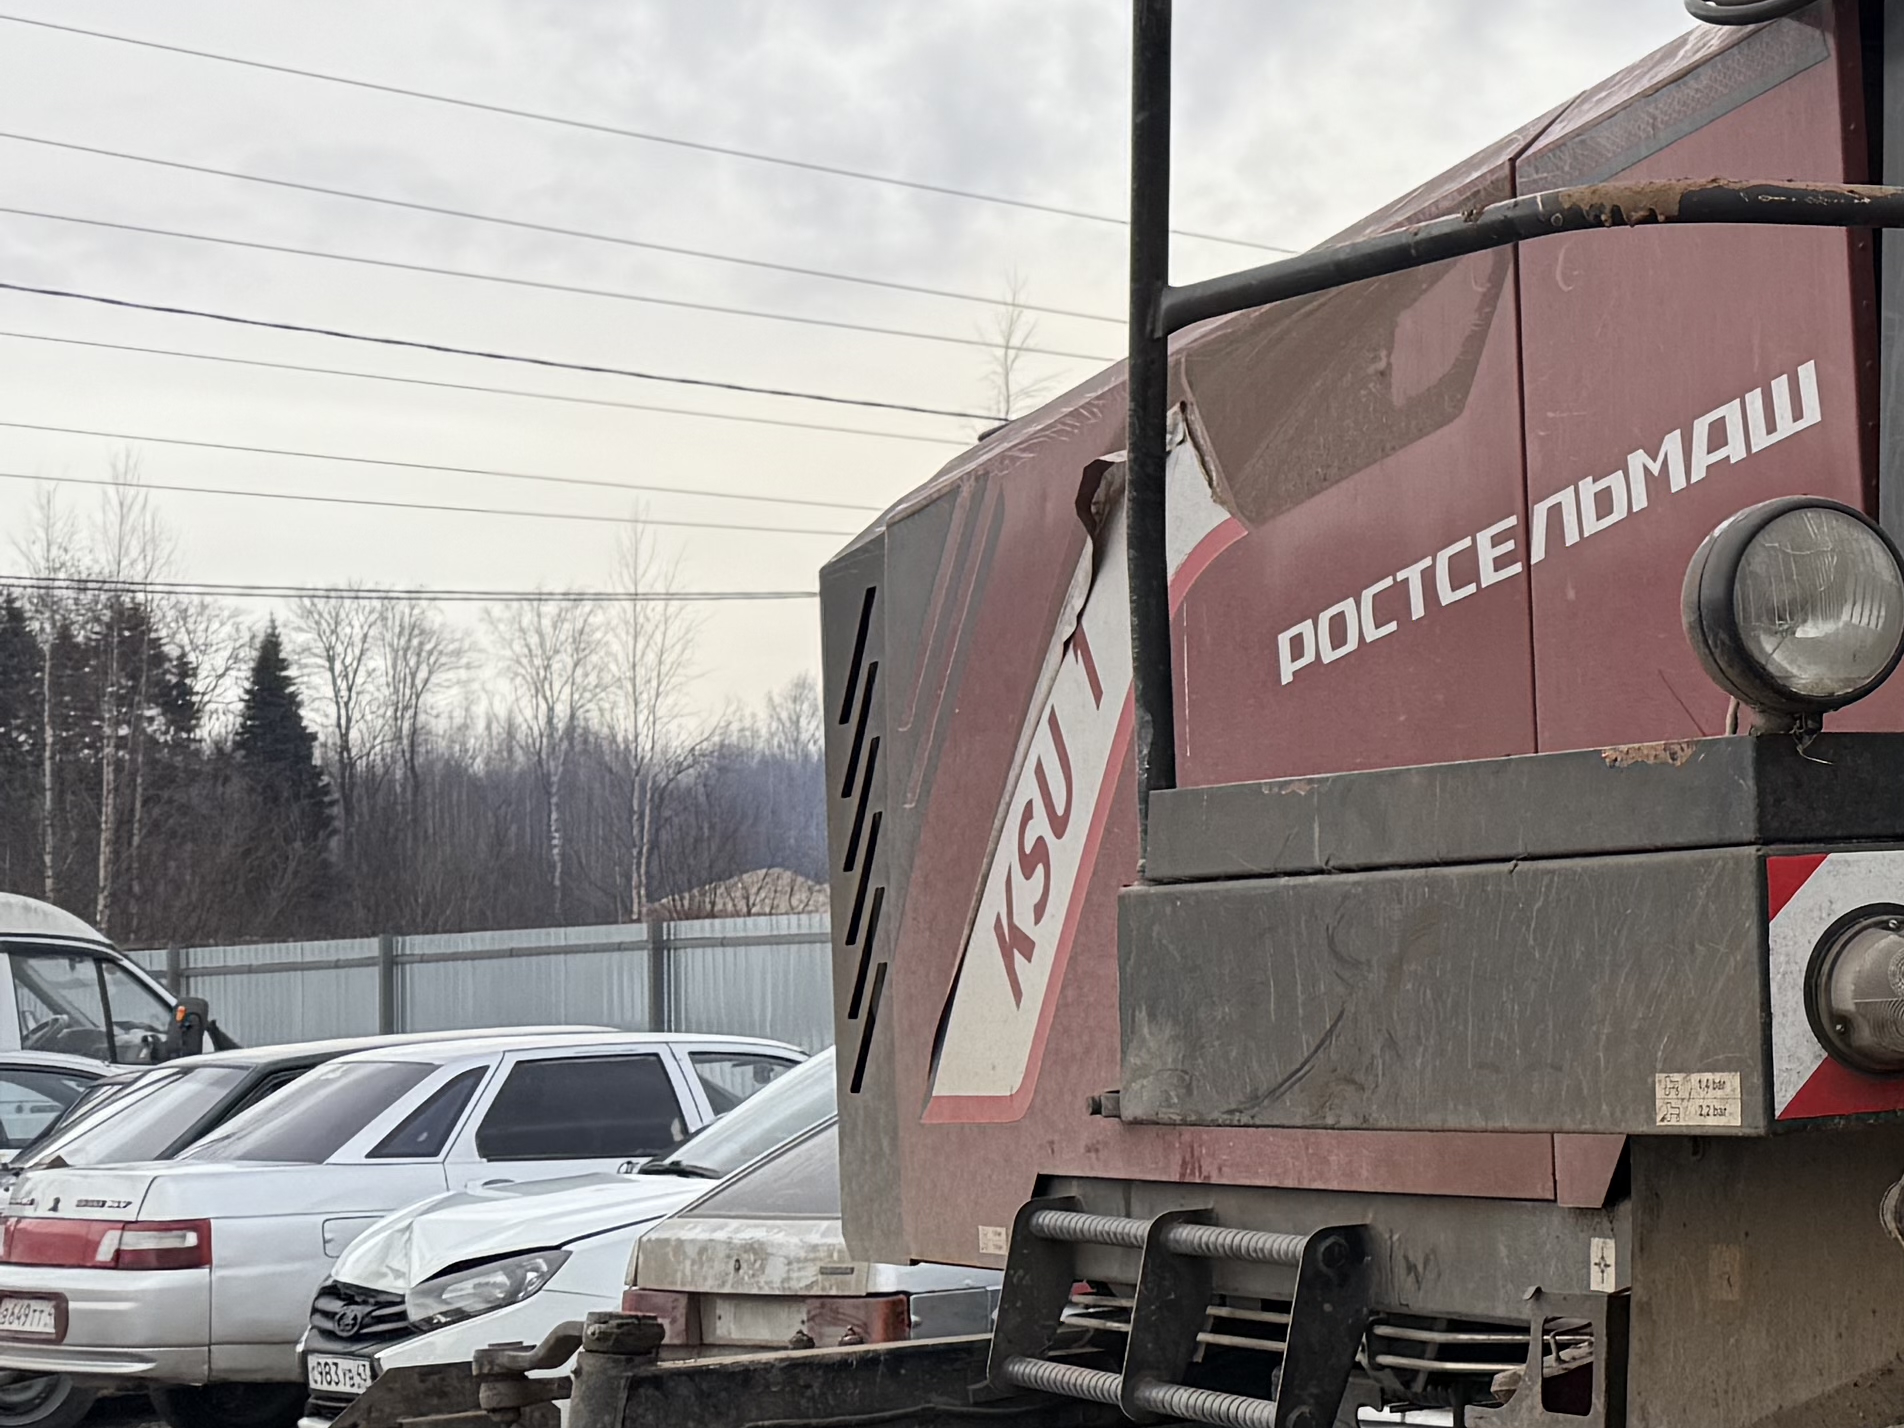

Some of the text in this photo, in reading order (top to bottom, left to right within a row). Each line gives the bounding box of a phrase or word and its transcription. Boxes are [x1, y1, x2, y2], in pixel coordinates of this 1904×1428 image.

[1277, 360, 1821, 685] РОСТСЕЛЬМАШ
[994, 622, 1103, 1011] KSU 1
[1712, 1105, 1727, 1117] bar
